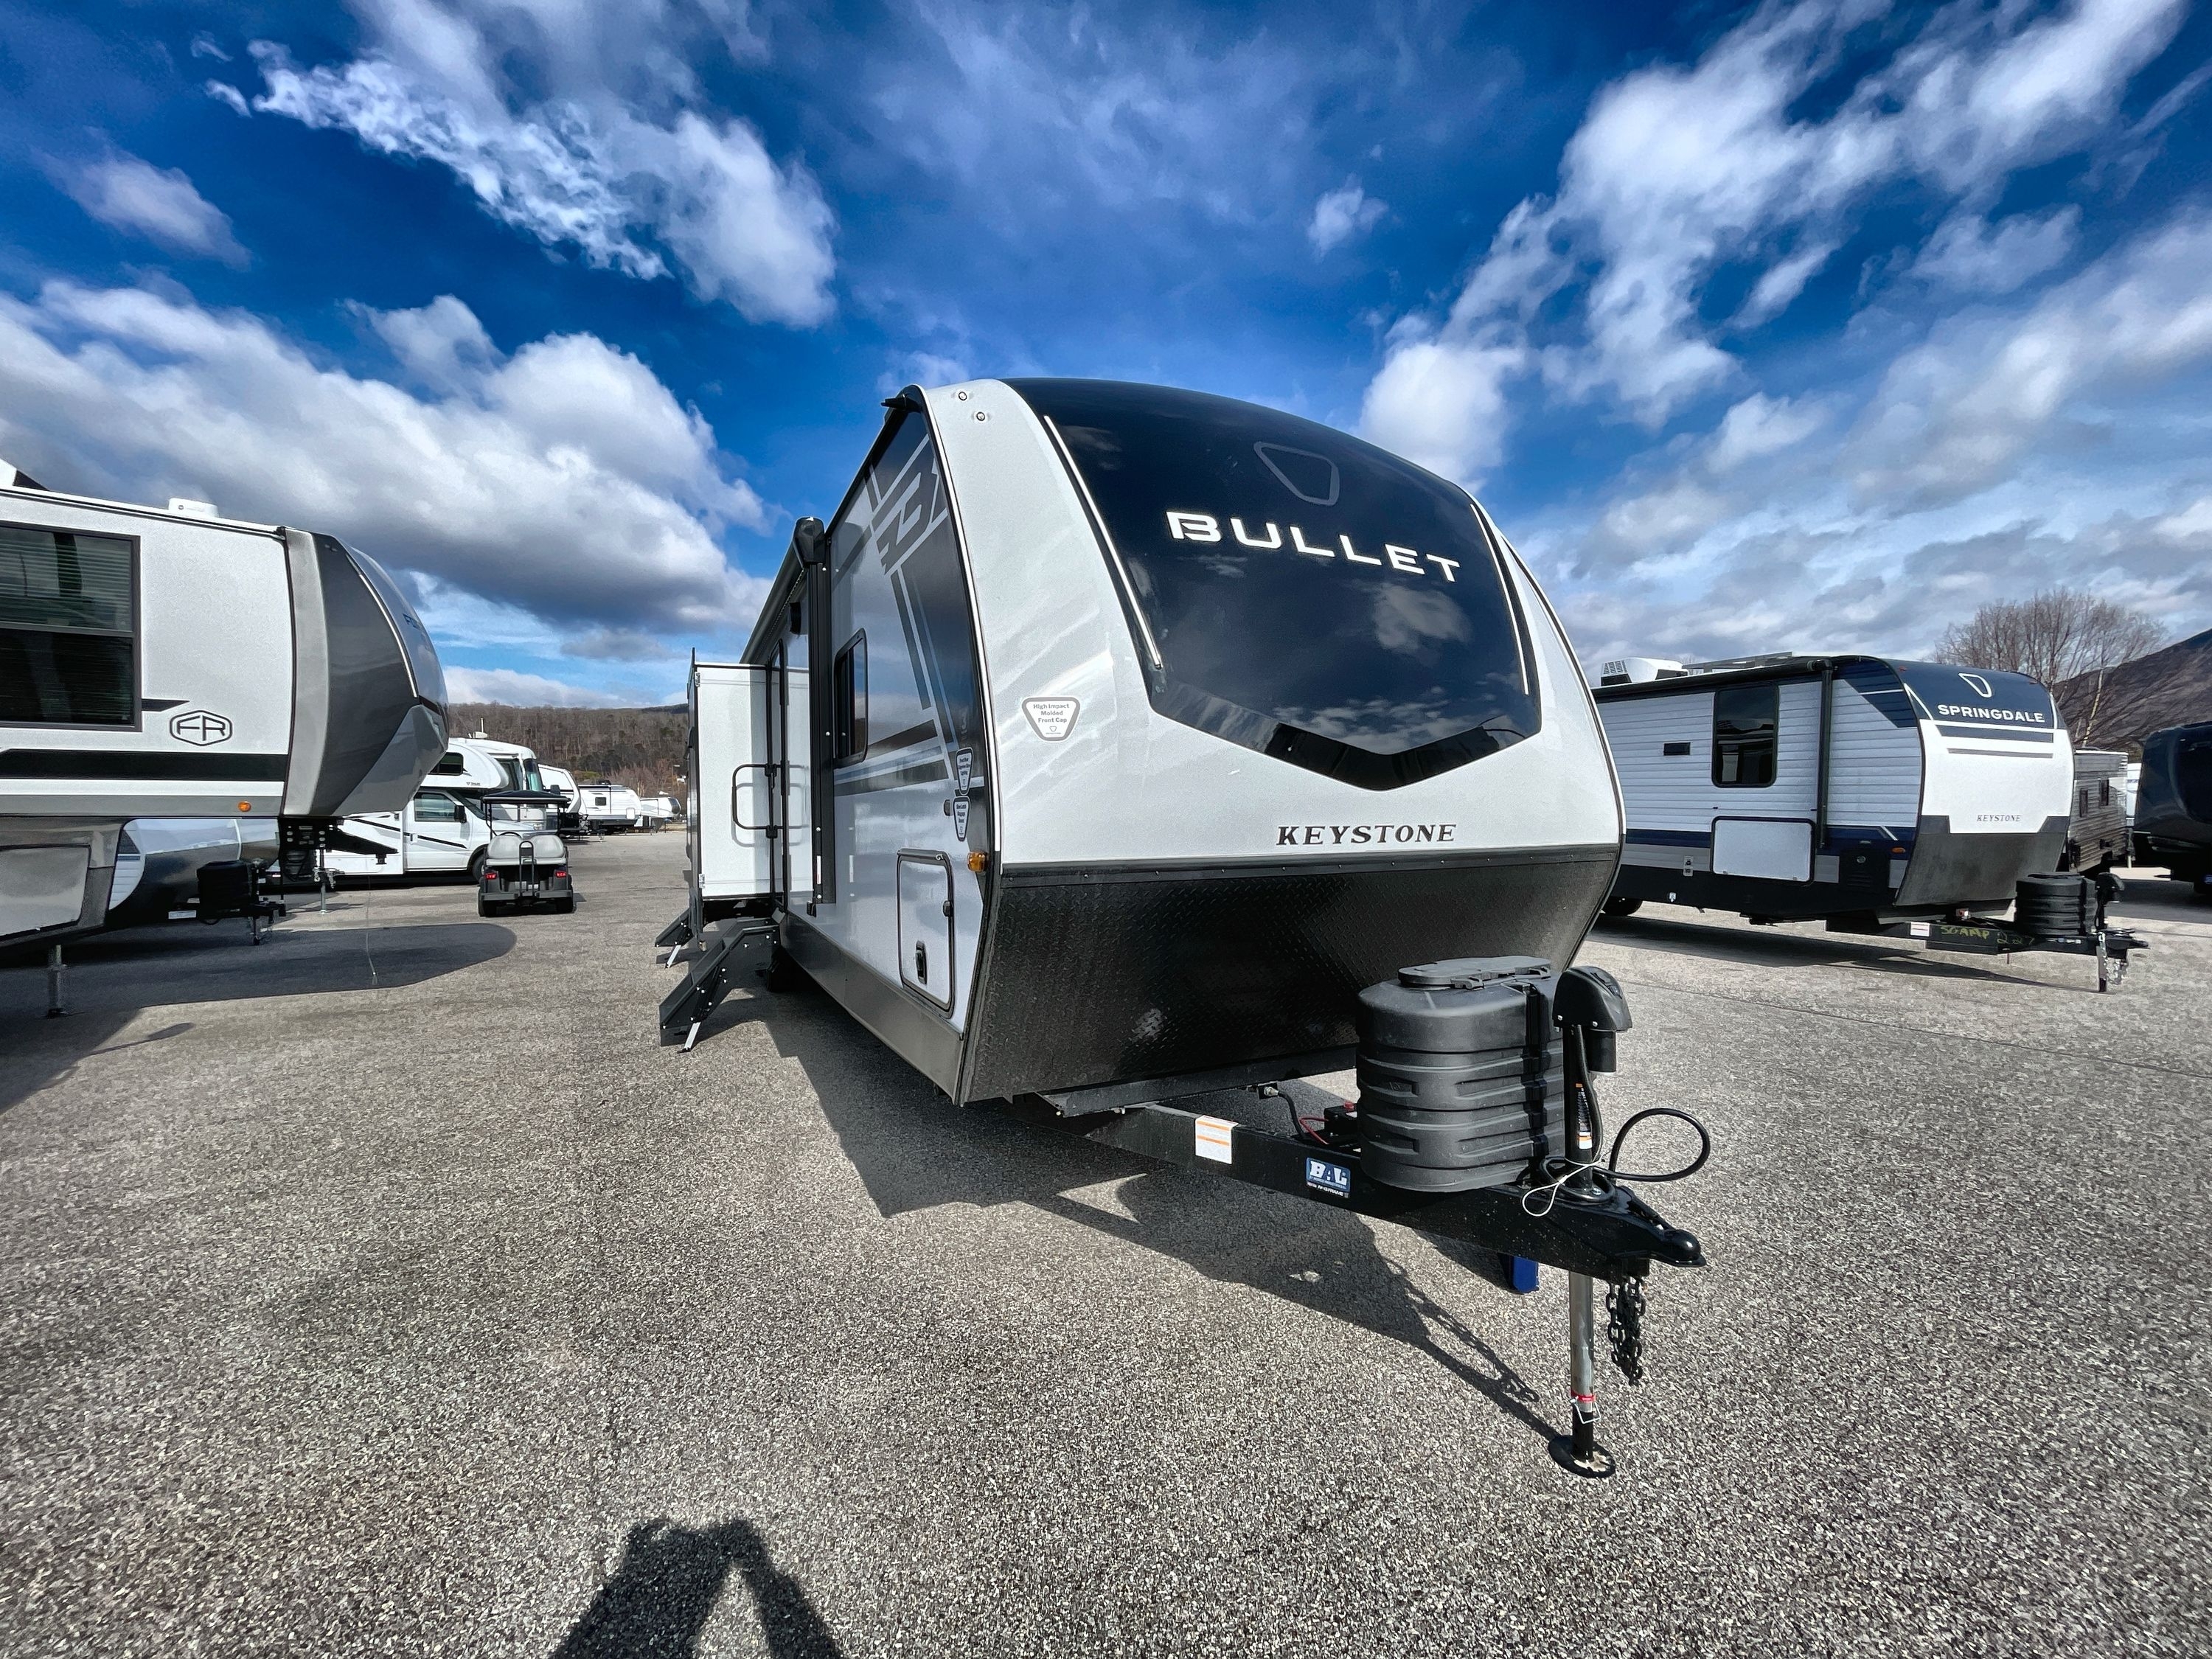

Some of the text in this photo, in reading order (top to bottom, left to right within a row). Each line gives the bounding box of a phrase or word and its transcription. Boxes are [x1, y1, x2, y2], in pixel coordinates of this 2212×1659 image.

[1165, 510, 1461, 583] BULLET
[1937, 705, 2045, 723] SPRINGDALE
[177, 715, 225, 741] FR
[1276, 823, 1457, 846] KEYSTONE
[1310, 1161, 1347, 1186] BAL
